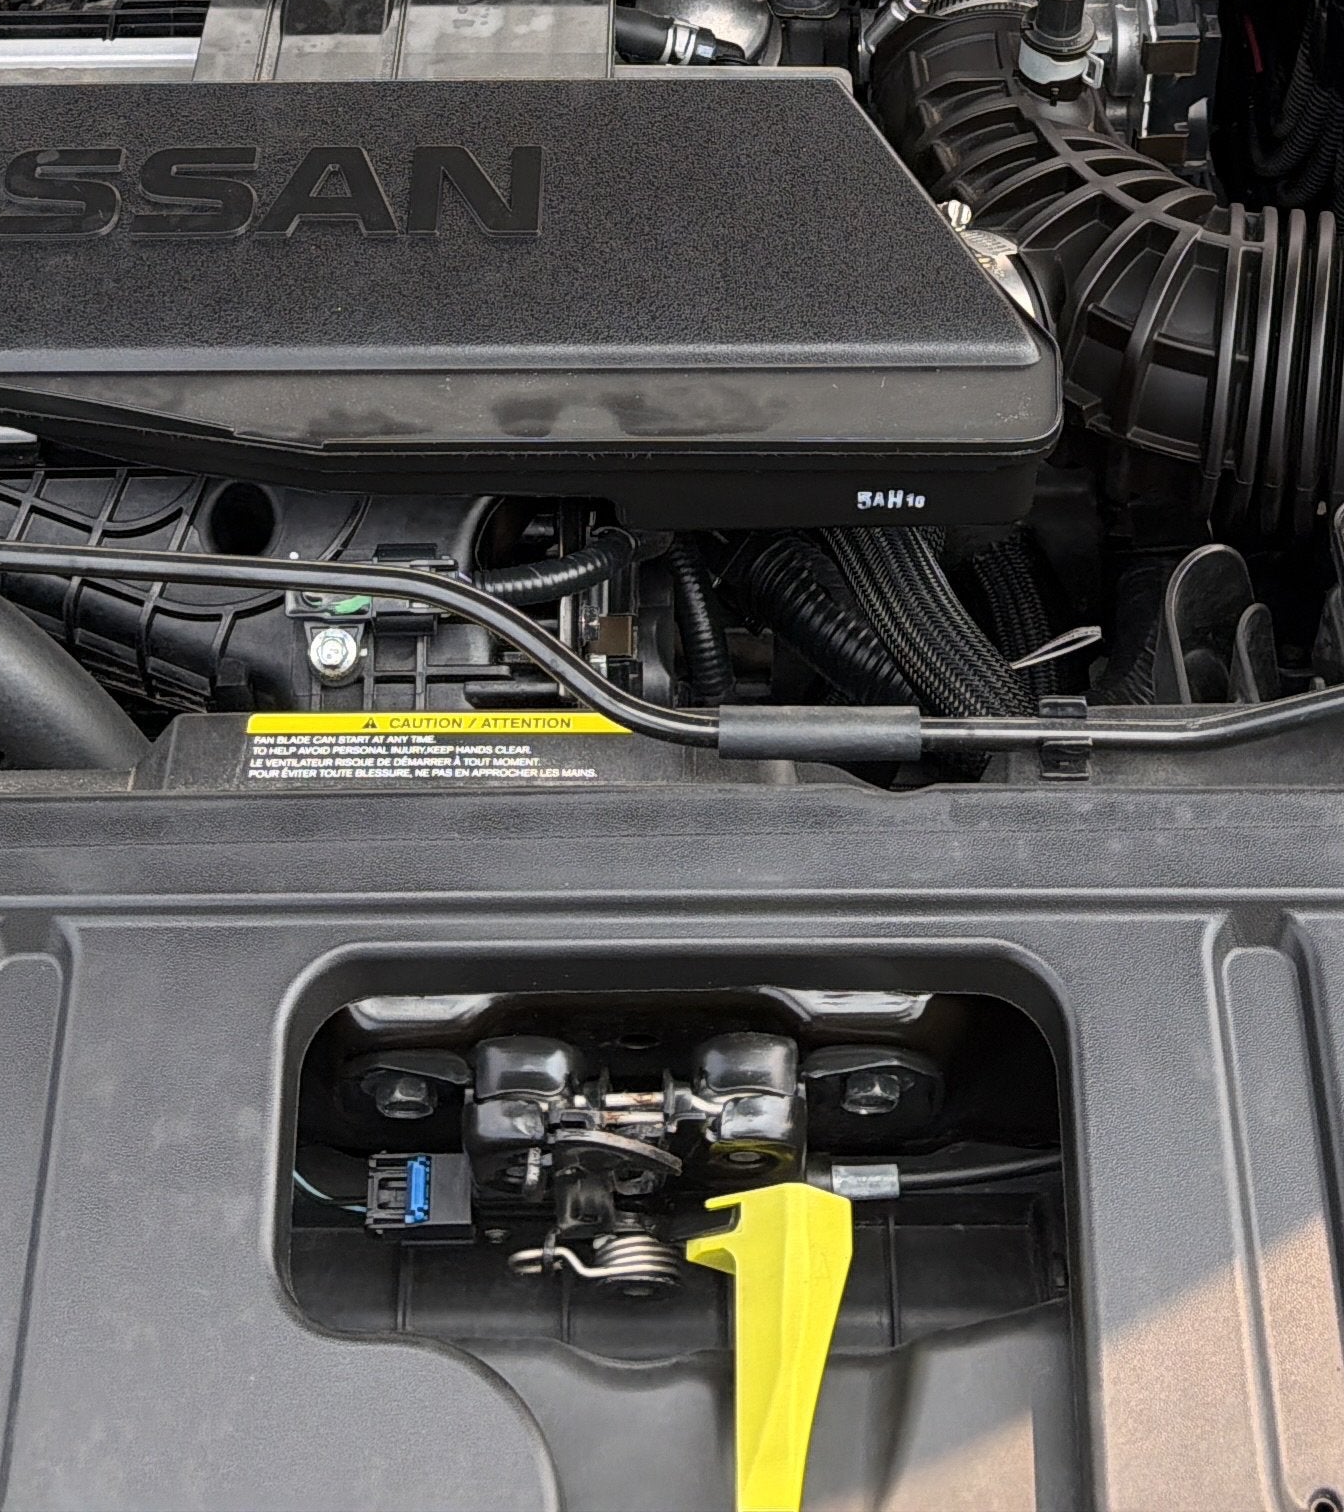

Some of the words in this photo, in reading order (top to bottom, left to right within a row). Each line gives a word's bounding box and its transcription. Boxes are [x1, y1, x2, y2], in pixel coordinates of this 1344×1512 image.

[389, 717, 462, 729] CAUTION
[467, 717, 477, 729] /
[481, 717, 571, 729] ATTENTION
[254, 735, 276, 745] FAN
[276, 735, 311, 745] BLADE
[312, 735, 336, 744] CAN
[338, 735, 371, 744] START
[371, 735, 386, 744] AT
[386, 735, 409, 744] ANY
[411, 735, 436, 744] TIME.
[253, 746, 267, 756] TO
[268, 746, 297, 756] HELP
[297, 746, 331, 756] AVOID
[332, 746, 390, 755] PERSONAL
[456, 745, 493, 755] HANDS
[494, 745, 532, 755] CLEAR.
[250, 758, 264, 768] LE
[265, 757, 333, 768] VENTILATEUR
[334, 757, 375, 768] RISQUE
[376, 757, 392, 767] DE
[393, 755, 453, 767] DÉMARRER
[453, 754, 462, 767] À
[463, 757, 491, 766] TOUT
[492, 757, 542, 767] MOMENT.
[248, 769, 280, 778] POUR
[281, 766, 317, 778] ÉVITER
[319, 768, 354, 778] TOUTE
[355, 768, 413, 778] BLESSURE,
[414, 768, 431, 778] NE
[432, 768, 453, 778] PAS
[455, 768, 470, 778] EN
[471, 768, 538, 778] APPROCHER
[539, 768, 560, 778] LES
[561, 768, 598, 778] MAINS.
